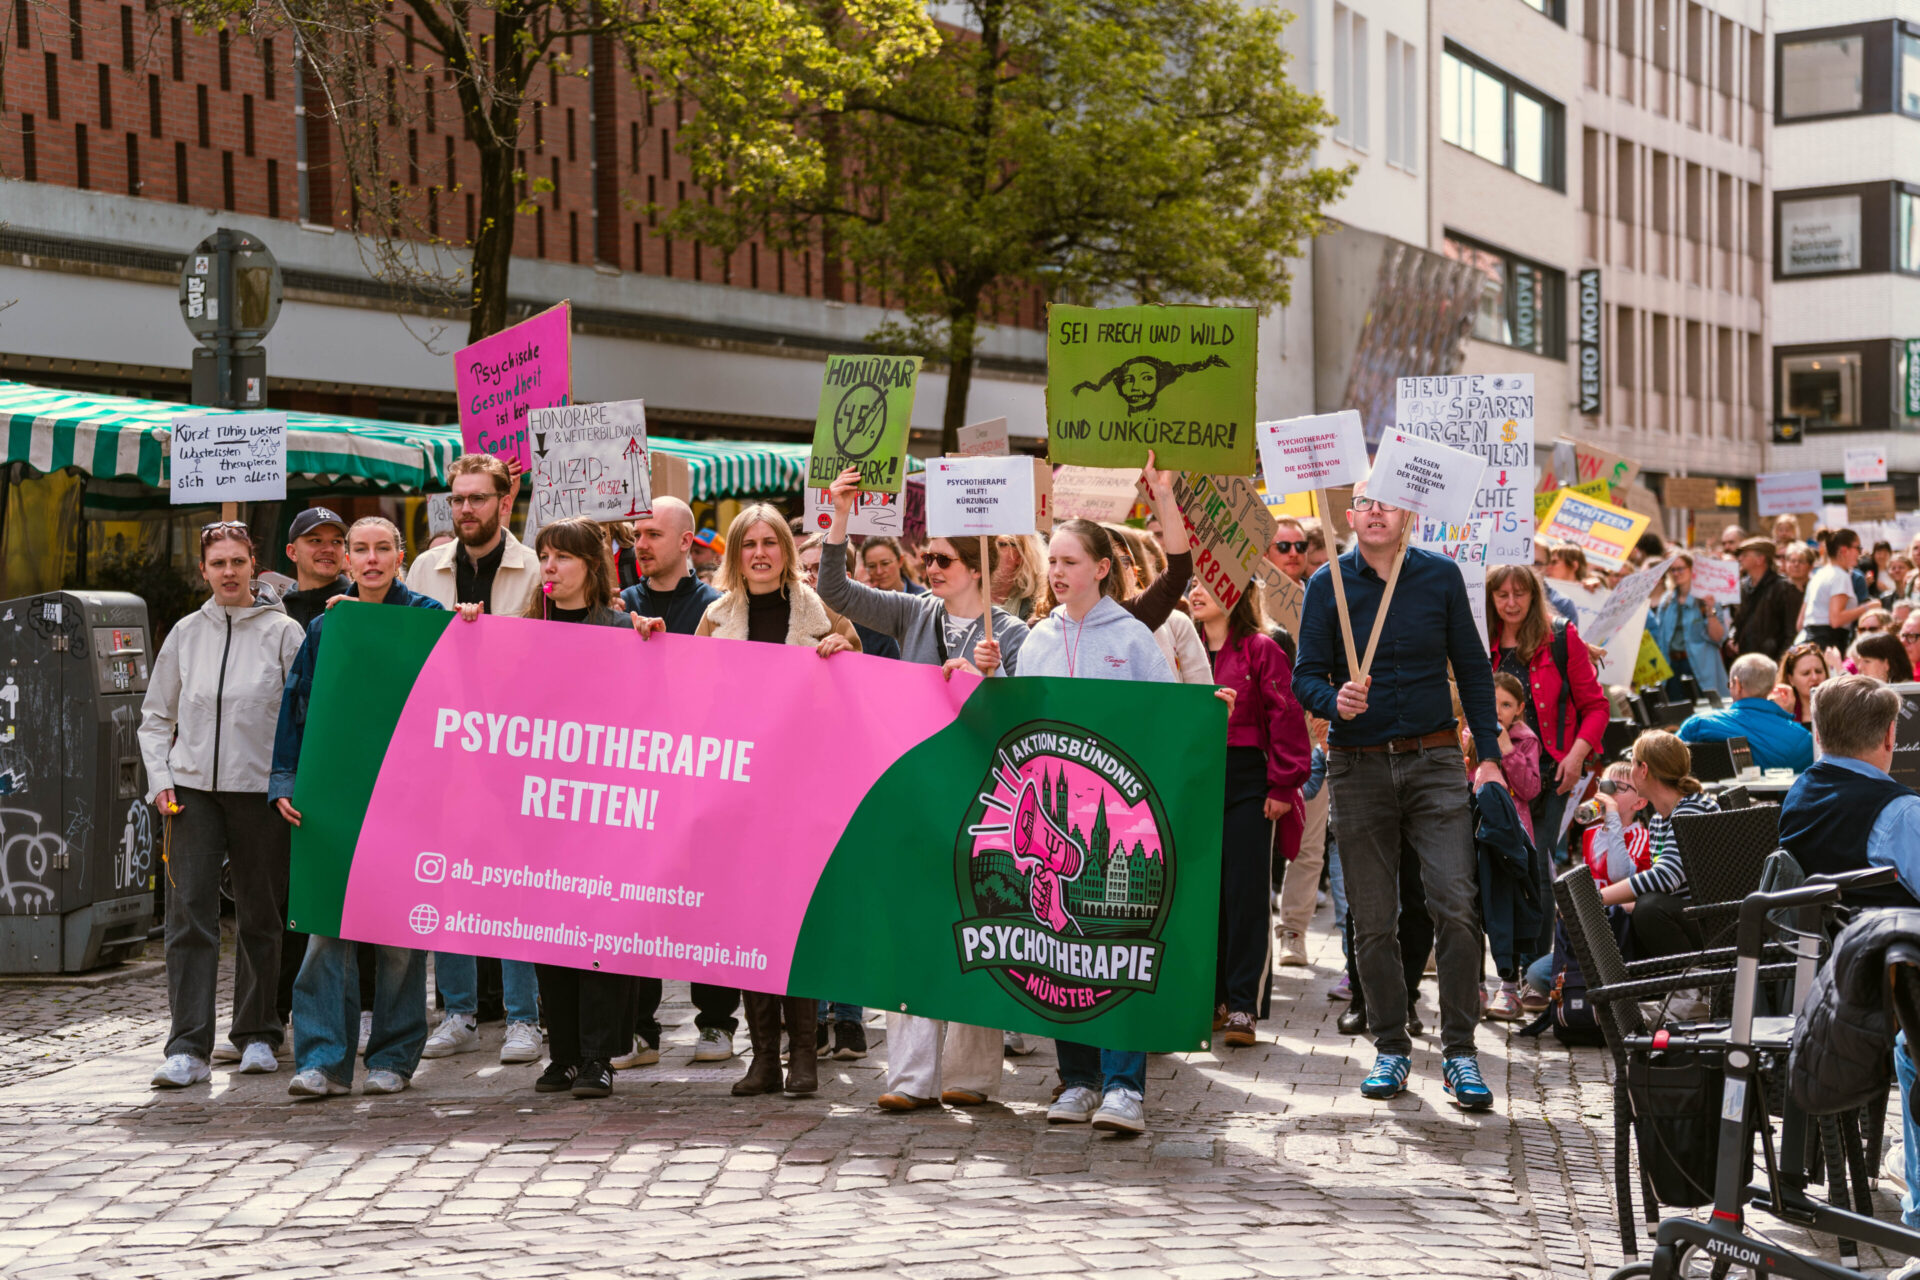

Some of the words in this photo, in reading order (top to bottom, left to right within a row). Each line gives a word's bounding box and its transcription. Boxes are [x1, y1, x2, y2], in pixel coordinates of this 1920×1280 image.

[1581, 271, 1599, 344] MODA
[1060, 322, 1088, 345] SEI
[1097, 323, 1143, 344] FRECH
[1150, 324, 1181, 344] UND
[1190, 323, 1235, 346] WILD
[470, 341, 540, 386] Psychische
[826, 357, 916, 390] HONORAR
[470, 364, 542, 416] Gesundheit
[1400, 375, 1485, 399] HEUTE
[1581, 347, 1599, 411] VERO
[496, 408, 509, 427] ist
[530, 405, 612, 431] HONORARE
[1447, 395, 1534, 420] SPAREN
[175, 423, 210, 443] Kürzt
[217, 425, 248, 440] ruhig
[554, 431, 562, 444] &
[563, 423, 642, 443] WEITERBILDUNG
[1056, 419, 1091, 440] UND
[1099, 417, 1238, 449] UNKÜRZBAR!
[1277, 432, 1338, 447] PSYCHOTHERAPIE-
[1283, 444, 1313, 455] MANGEL
[1313, 442, 1335, 451] HEUTE
[1297, 461, 1324, 471] KOSTEN
[1326, 458, 1341, 467] VON
[1297, 469, 1330, 480] MORGEN!
[1404, 462, 1431, 477] KÜRZEN
[1432, 471, 1443, 481] AN
[1412, 455, 1441, 470] KASSEN
[178, 475, 204, 489] sich
[216, 475, 237, 486] von
[244, 470, 280, 483] allein
[946, 478, 1007, 486] PSYCHOTHERAPIE
[1396, 469, 1411, 479] DER
[1411, 474, 1446, 490] FALSCHEN
[1406, 482, 1430, 495] STELLE
[537, 487, 592, 520] RATE
[956, 497, 999, 505] KÜRZUNGEN
[1422, 520, 1482, 543] HÄNDE
[1555, 512, 1592, 532] WAS
[1442, 543, 1487, 567] WEG!
[434, 707, 755, 783] PSYCHOTHERAPIE
[1011, 732, 1143, 799] AKTIONSBÜNDNIS
[520, 775, 660, 831] RETTEN!
[450, 857, 705, 908] ab_psychotherapie_muenster
[444, 910, 768, 971] aktionsbuendnis-psychotherapie.info
[962, 925, 1156, 982] PSYCHOTHERAPIE
[1025, 972, 1096, 1008] MÜNSTER
[1706, 1238, 1761, 1265] ATHLON
